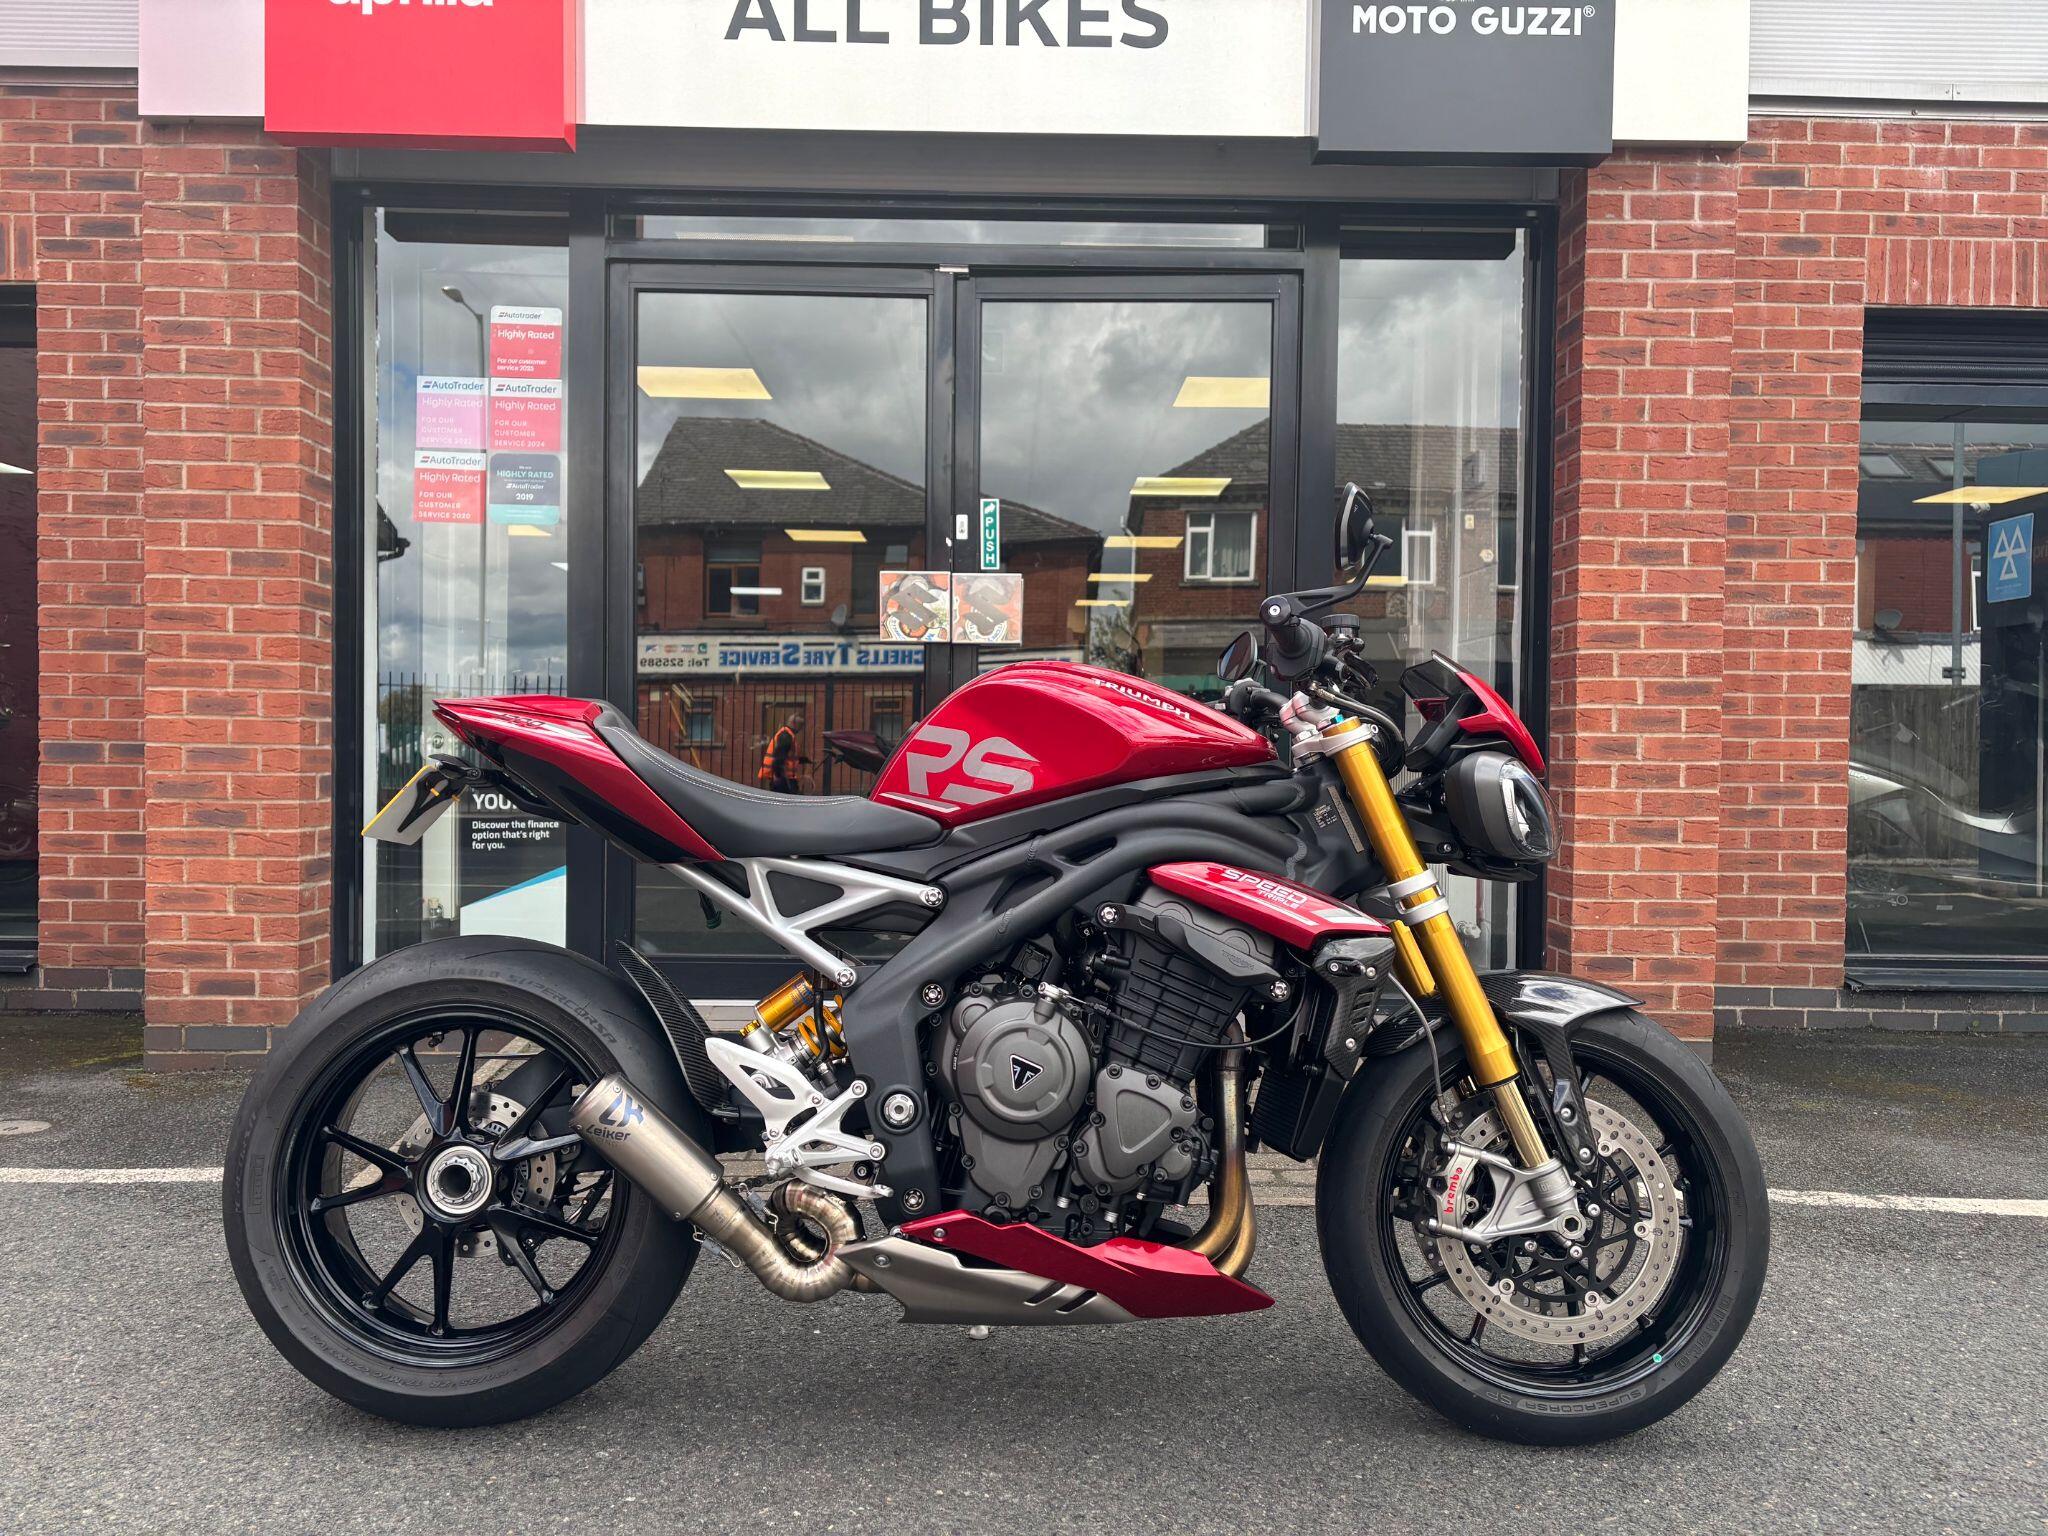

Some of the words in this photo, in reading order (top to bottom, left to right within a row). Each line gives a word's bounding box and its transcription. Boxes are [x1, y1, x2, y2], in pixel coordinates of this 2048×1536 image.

[724, 0, 890, 44] ALL
[919, 0, 1169, 49] BIKES
[1352, 5, 1457, 35] MOTO
[497, 328, 526, 340] Highly
[528, 330, 555, 340] Rated
[432, 381, 484, 391] AutoTrader
[505, 384, 557, 393] AutoTrader
[422, 397, 452, 408] Highly
[454, 399, 483, 408] Rated
[495, 400, 525, 411] Highly
[528, 401, 556, 411] Rated
[494, 429, 536, 437] CUSTOMER
[430, 456, 481, 466] AutoTrader
[419, 472, 450, 483] Highly
[452, 473, 480, 483] Rated
[497, 470, 525, 478] HIGHLY
[418, 501, 461, 509] CUSTOMER
[418, 511, 450, 519] SERVICE
[985, 516, 995, 564] PUSH
[1091, 678, 1190, 720] TRIUMPH
[907, 725, 1040, 805] RS
[472, 793, 517, 810] YOU
[472, 820, 509, 829] Discover
[511, 820, 525, 829] the
[528, 820, 559, 828] finance
[472, 831, 500, 841] option
[502, 830, 527, 839] that's
[529, 830, 550, 840] right
[472, 841, 485, 850] for
[487, 842, 505, 851] you.
[1221, 869, 1308, 906] SPEED
[586, 1125, 632, 1141] Leiker
[1444, 1166, 1463, 1214] brembo
